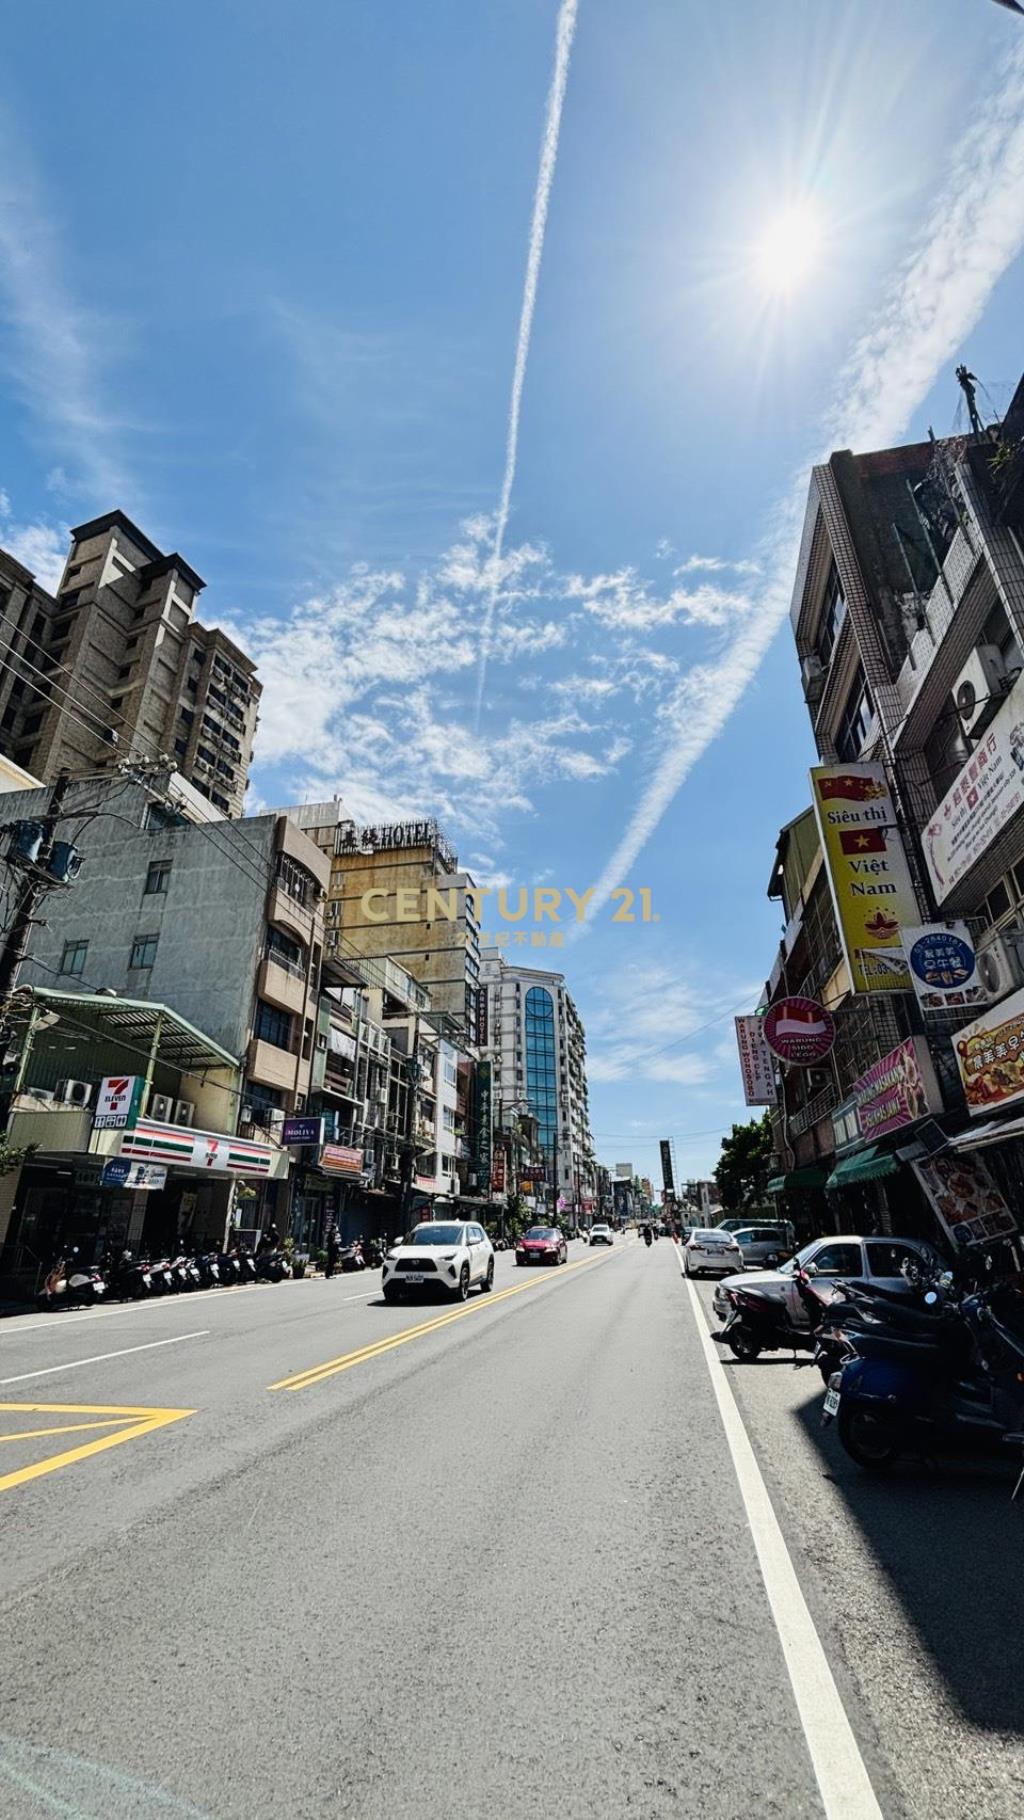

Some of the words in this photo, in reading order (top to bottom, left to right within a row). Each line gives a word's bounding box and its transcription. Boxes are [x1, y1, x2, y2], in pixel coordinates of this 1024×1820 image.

[827, 811, 860, 825] Siêu
[863, 806, 888, 823] thị
[381, 823, 433, 847] HOTEL
[849, 859, 890, 875] Việt
[850, 882, 897, 897] Nam
[738, 1016, 749, 1050] WARUNG
[749, 1031, 759, 1060] DIENG
[760, 1049, 774, 1096] TENGAH
